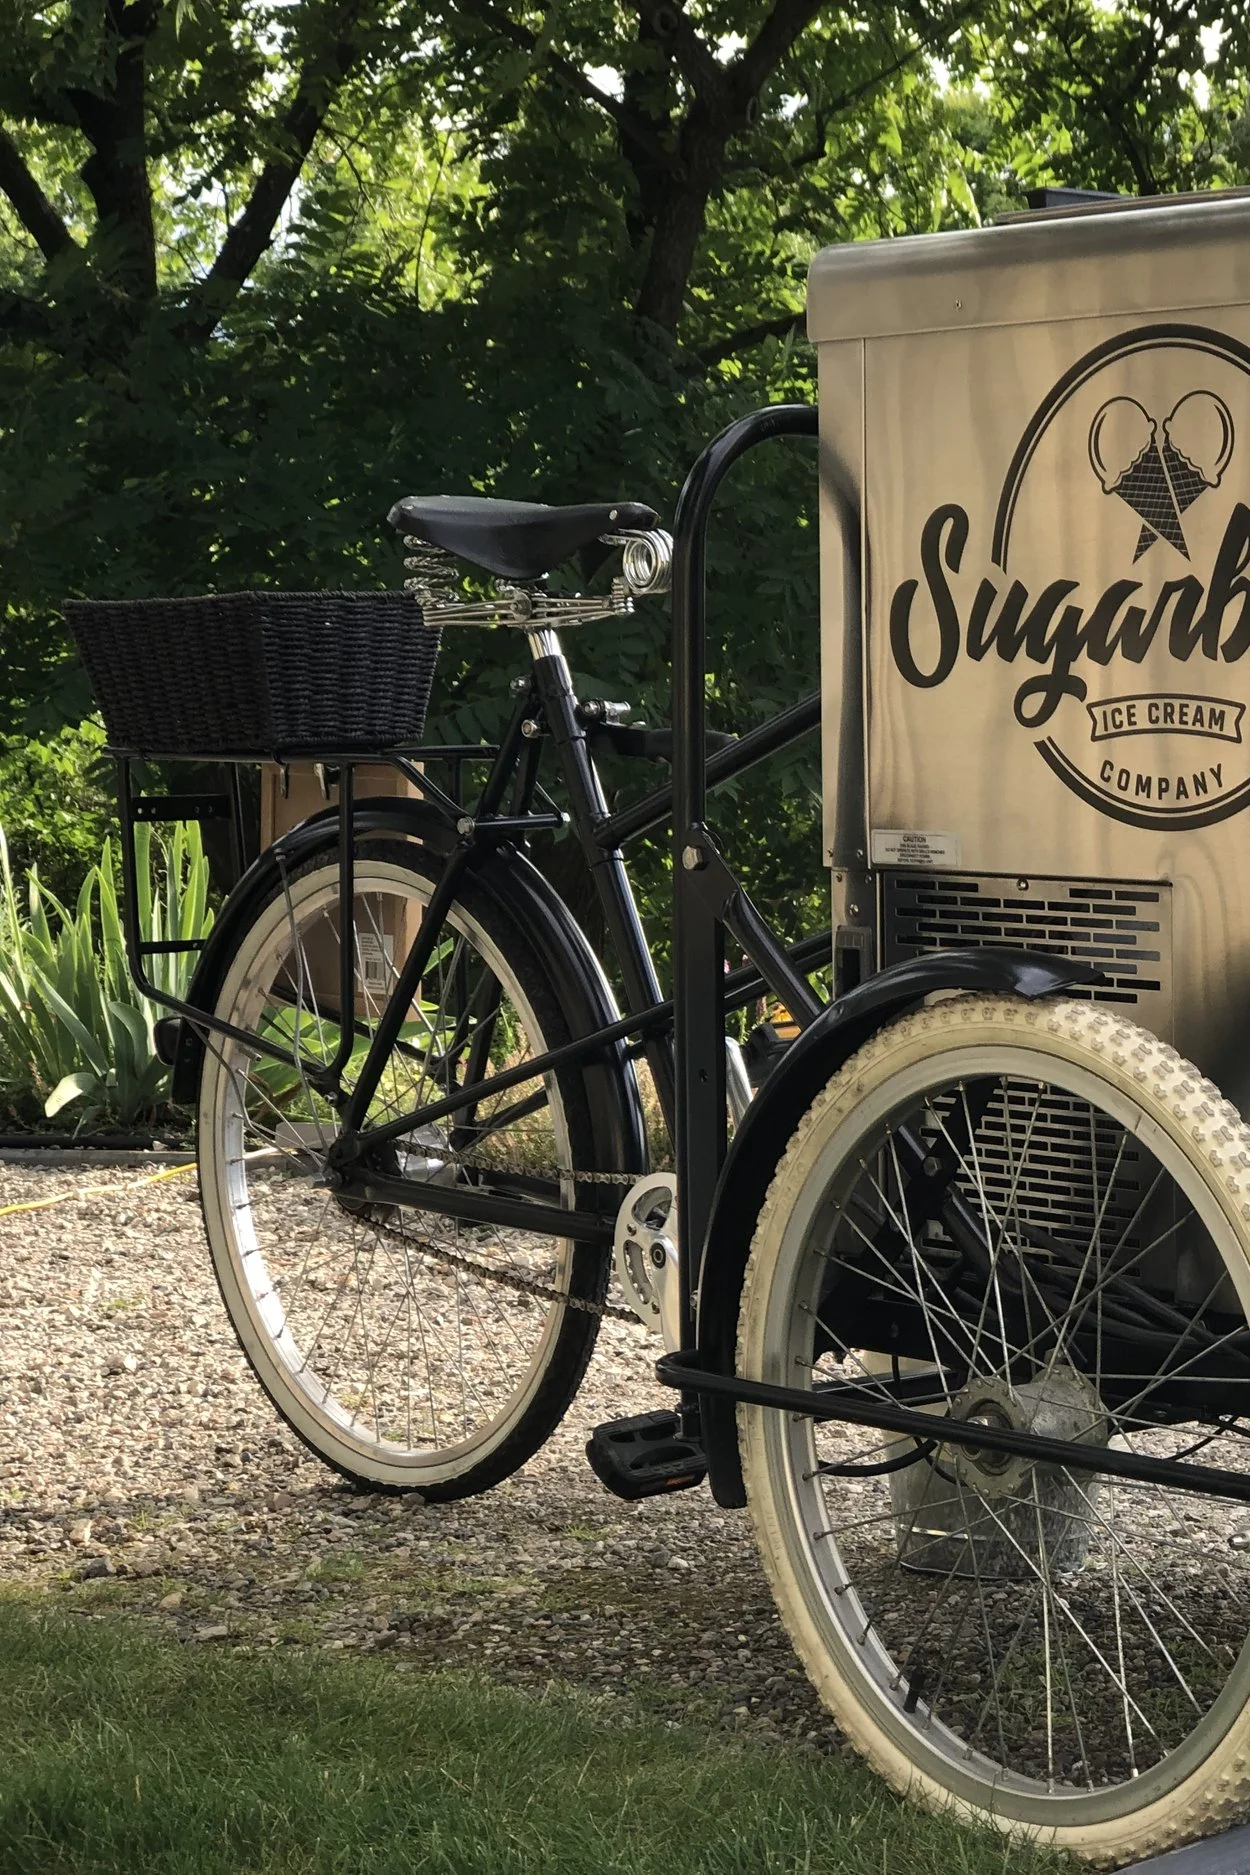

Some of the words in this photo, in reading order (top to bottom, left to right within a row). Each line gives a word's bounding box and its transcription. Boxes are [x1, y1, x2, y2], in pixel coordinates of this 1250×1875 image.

[1102, 704, 1137, 732] ICE
[1147, 702, 1226, 732] CREAM
[1100, 759, 1223, 801] COMPANY
[902, 835, 927, 843] CAUTION
